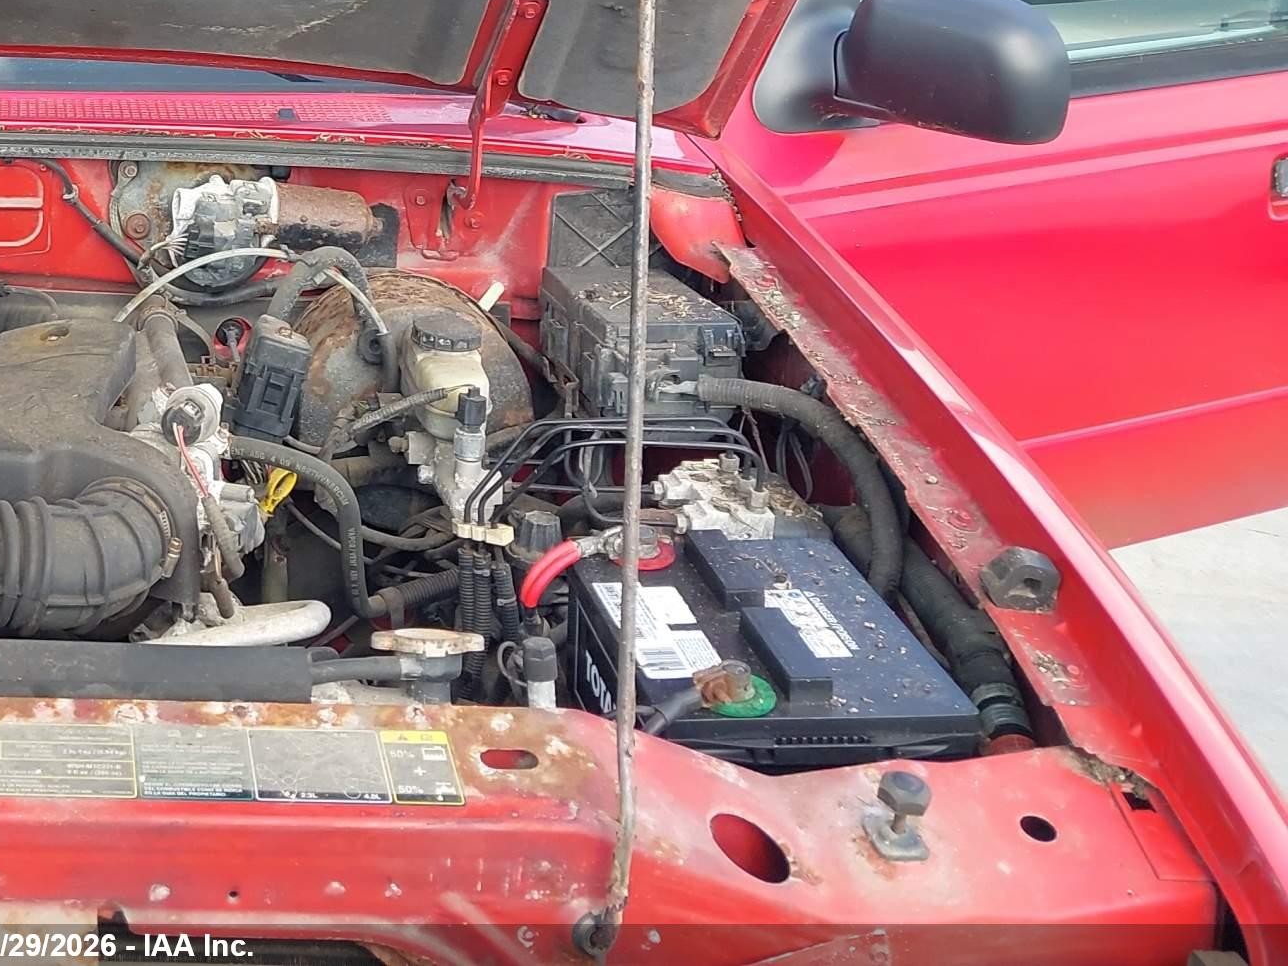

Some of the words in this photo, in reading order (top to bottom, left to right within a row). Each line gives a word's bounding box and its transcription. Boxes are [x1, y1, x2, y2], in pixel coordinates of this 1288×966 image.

[585, 650, 616, 713] TOTA
[390, 749, 415, 758] 50%
[397, 785, 425, 794] 50%
